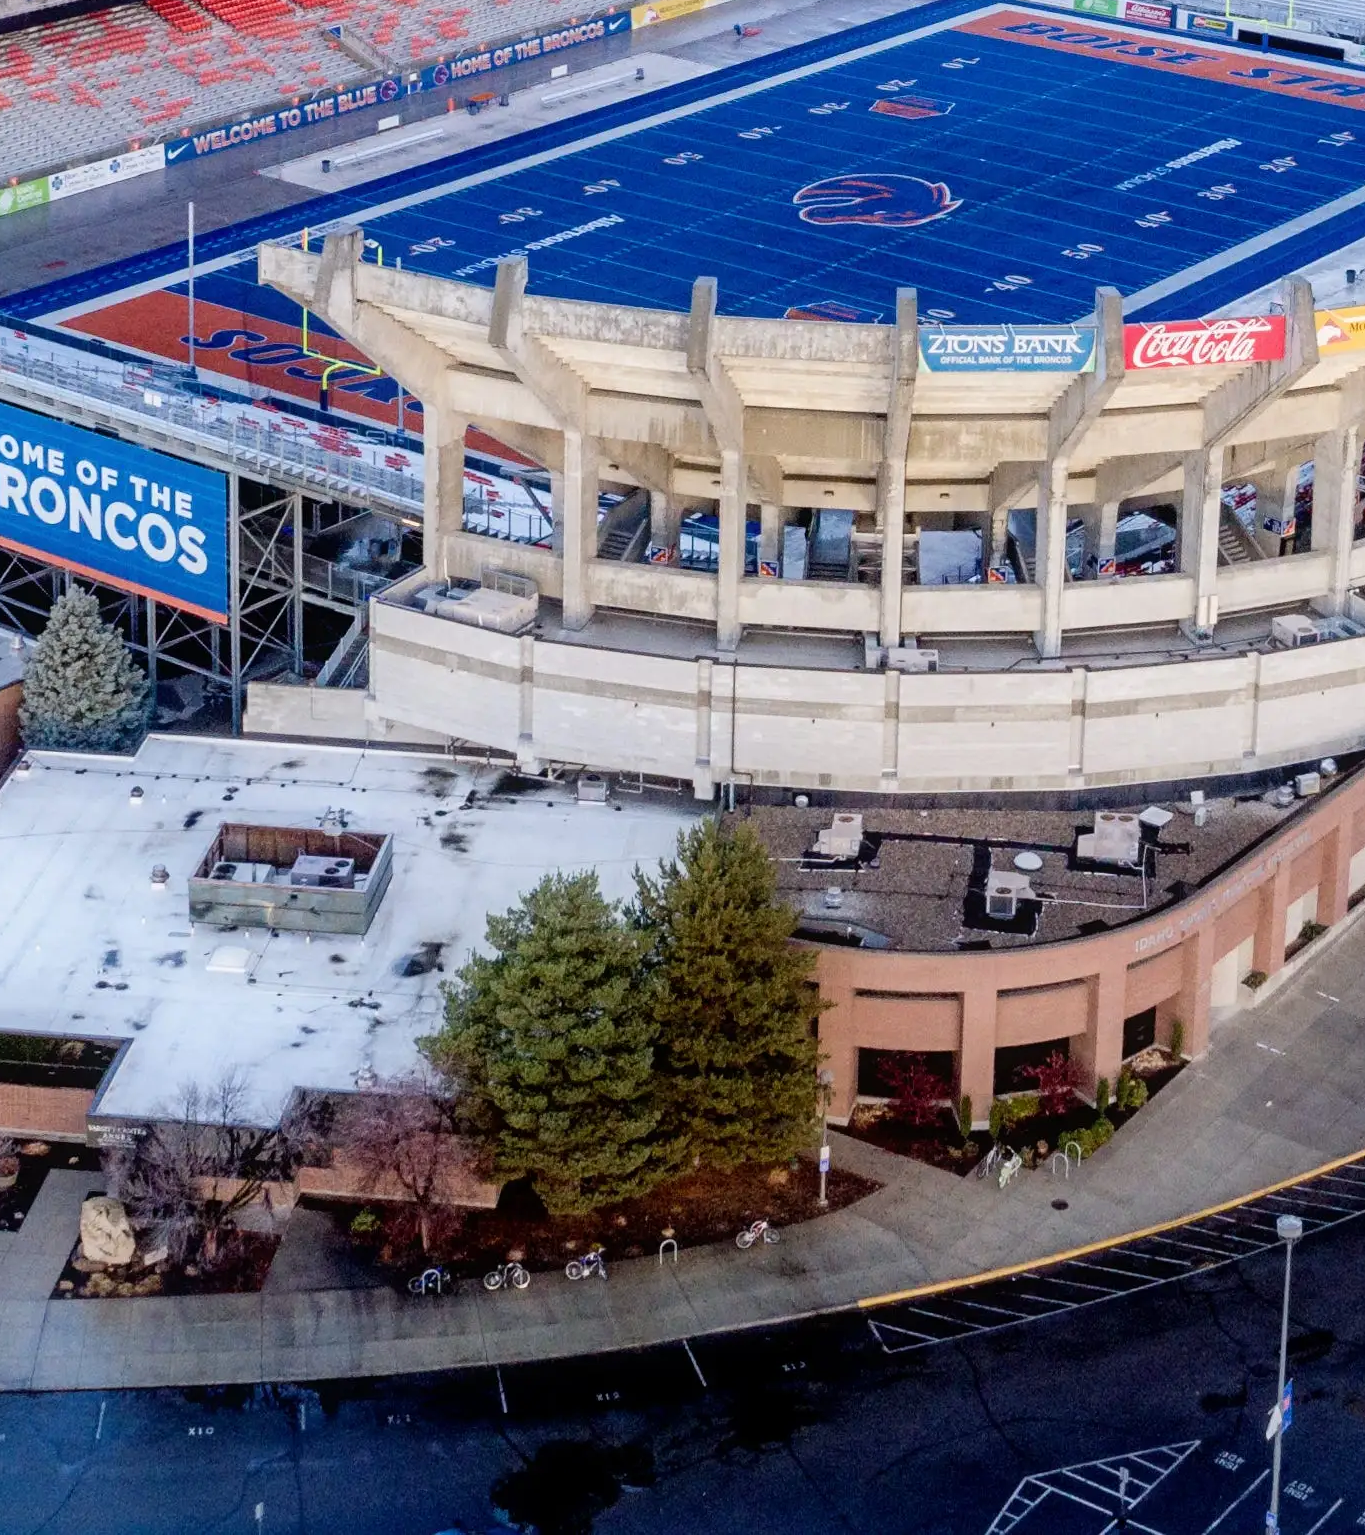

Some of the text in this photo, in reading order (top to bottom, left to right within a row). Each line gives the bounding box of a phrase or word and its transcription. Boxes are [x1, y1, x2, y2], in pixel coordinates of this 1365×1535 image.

[451, 20, 604, 79] HOME OF THE BRONCOS
[1000, 20, 1225, 66] BOISE
[193, 86, 378, 155] WELCOME TO THE BLUE
[1113, 138, 1242, 192] Albertsons STADIUM
[1259, 156, 1294, 174] 20
[1197, 184, 1233, 201] 30
[1135, 211, 1171, 230] 40
[524, 214, 625, 251] Albertsons
[1062, 243, 1104, 260] 50
[994, 275, 1032, 292] 40
[928, 335, 1085, 354] ZIONS BANK
[940, 356, 1072, 364] OFFICIAL BANK OF THE BRONCOS
[76, 460, 118, 491] OF
[129, 476, 193, 519] THE
